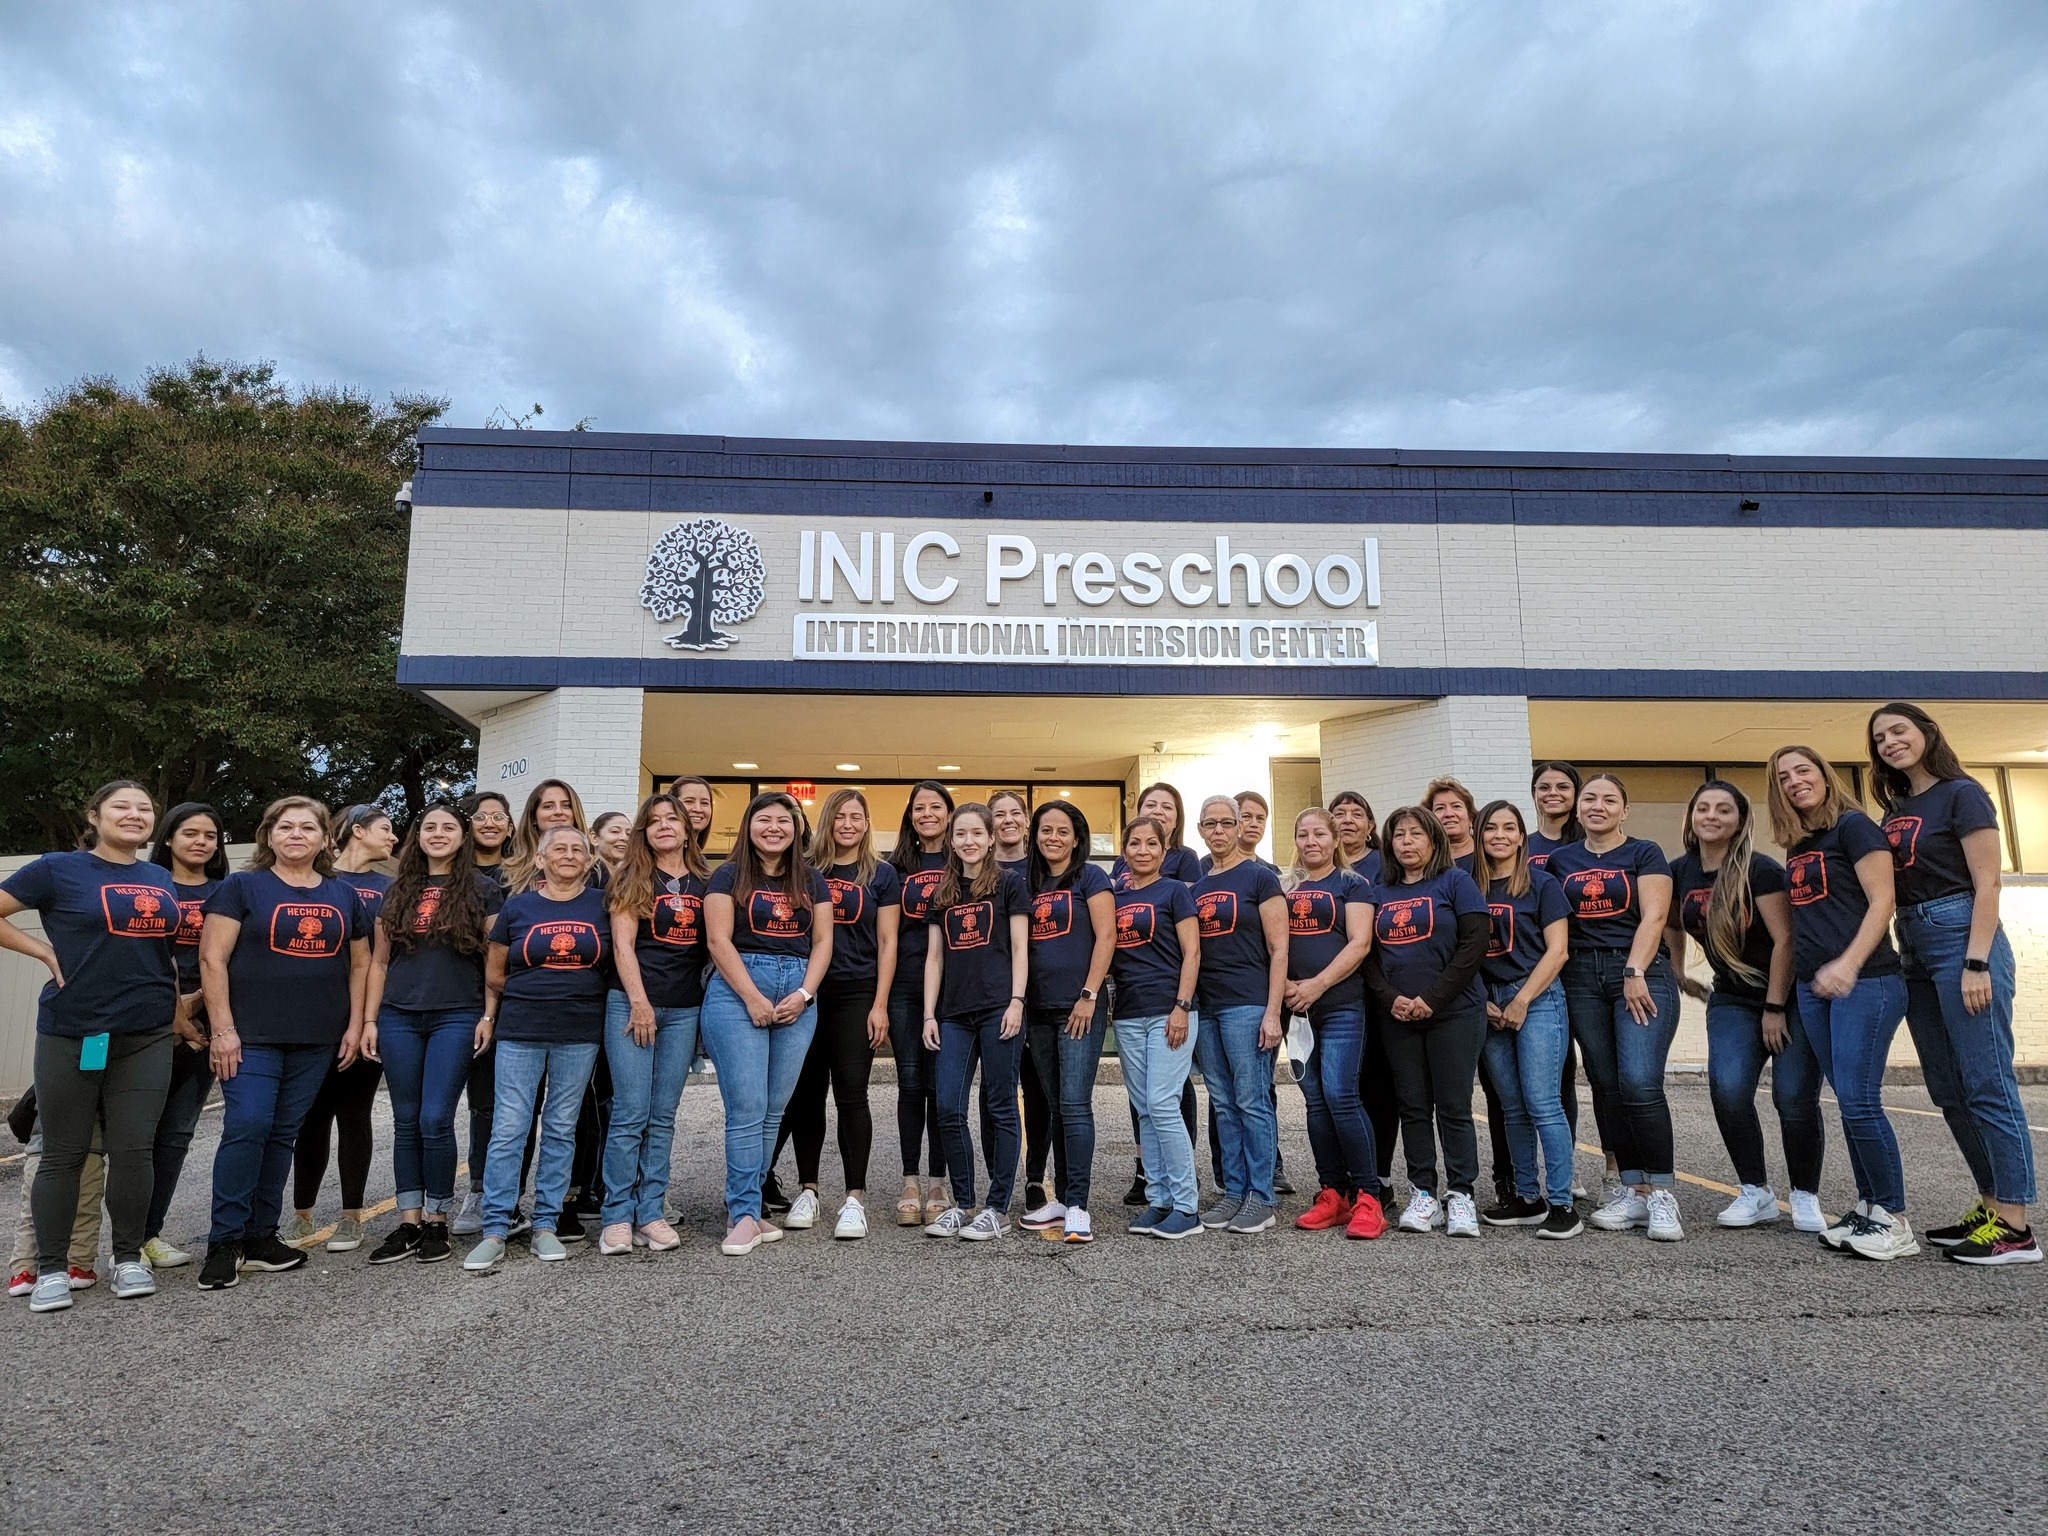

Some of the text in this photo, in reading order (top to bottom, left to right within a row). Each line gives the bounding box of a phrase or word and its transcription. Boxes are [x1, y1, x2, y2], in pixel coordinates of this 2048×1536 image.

[798, 530, 1382, 609] INIC Preschool
[805, 620, 1366, 659] INTERNATIONAL IMMERSION CENTER
[501, 758, 528, 780] 2100
[790, 783, 813, 800] EXIT
[915, 874, 940, 884] HECHO
[1574, 872, 1616, 882] HECHO EN
[114, 887, 165, 898] HECHO EN
[363, 891, 374, 899] EN
[1053, 893, 1064, 901] EN
[761, 894, 787, 904] HECHO
[1217, 895, 1228, 903] EN
[1579, 898, 1613, 911] AUSTIN
[1387, 901, 1413, 911] HECHO
[287, 907, 333, 918] HECHO EN
[954, 907, 975, 917] HECHO
[128, 917, 166, 929] AUSTIN
[766, 920, 799, 930] AUSTIN
[1032, 920, 1057, 933] AUSTIN
[1200, 919, 1220, 930] USTIN
[540, 925, 586, 935] HECHO EN
[667, 927, 697, 937] AUSTIN
[958, 929, 980, 941] AUSTIN
[1117, 930, 1140, 941] USTIN
[1388, 925, 1417, 937] AUSTIN
[288, 938, 326, 950] AUSTIN
